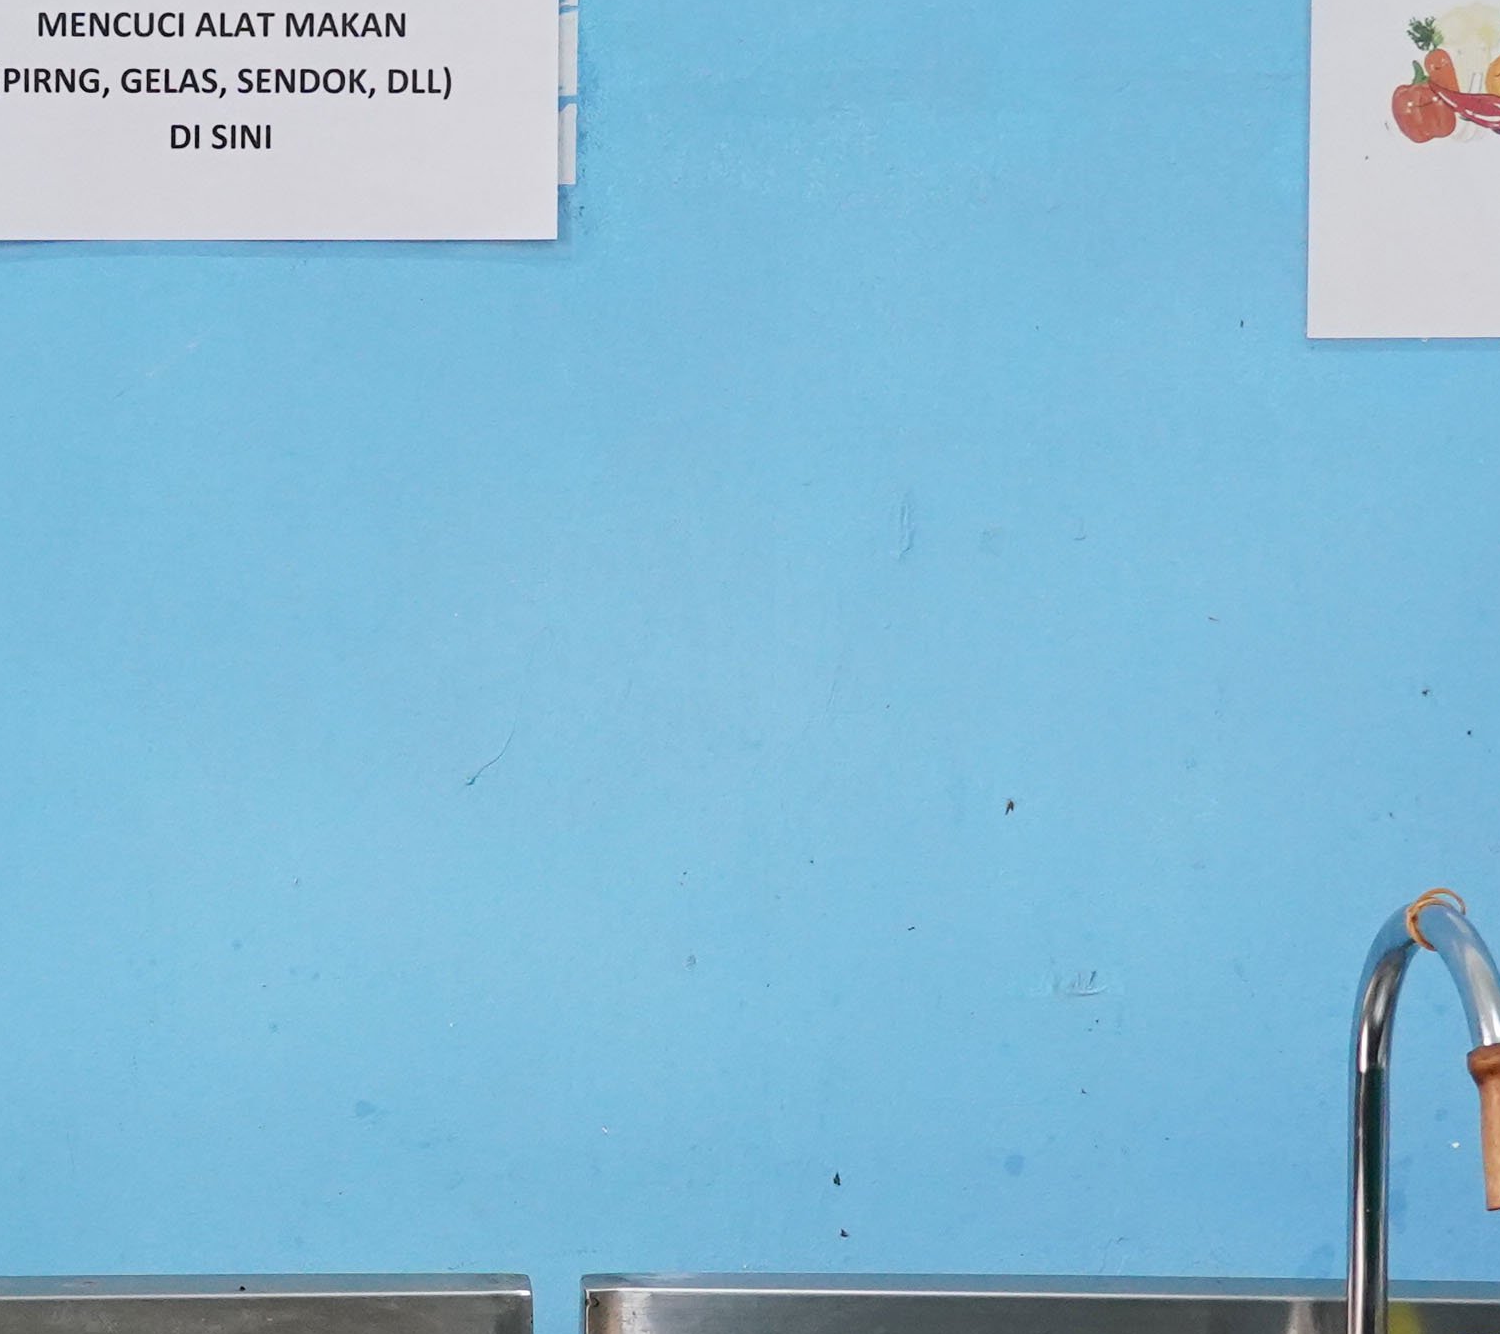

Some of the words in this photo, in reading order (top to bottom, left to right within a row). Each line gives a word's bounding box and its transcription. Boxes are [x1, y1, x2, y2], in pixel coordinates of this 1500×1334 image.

[38, 12, 184, 38] MENCUCI
[195, 12, 275, 38] ALAT
[286, 12, 406, 38] MAKAN
[120, 68, 227, 98] GELAS,
[237, 68, 376, 98] SENDOK,
[388, 66, 452, 99] DLL)
[170, 124, 200, 150] DI
[212, 124, 272, 150] SINI
